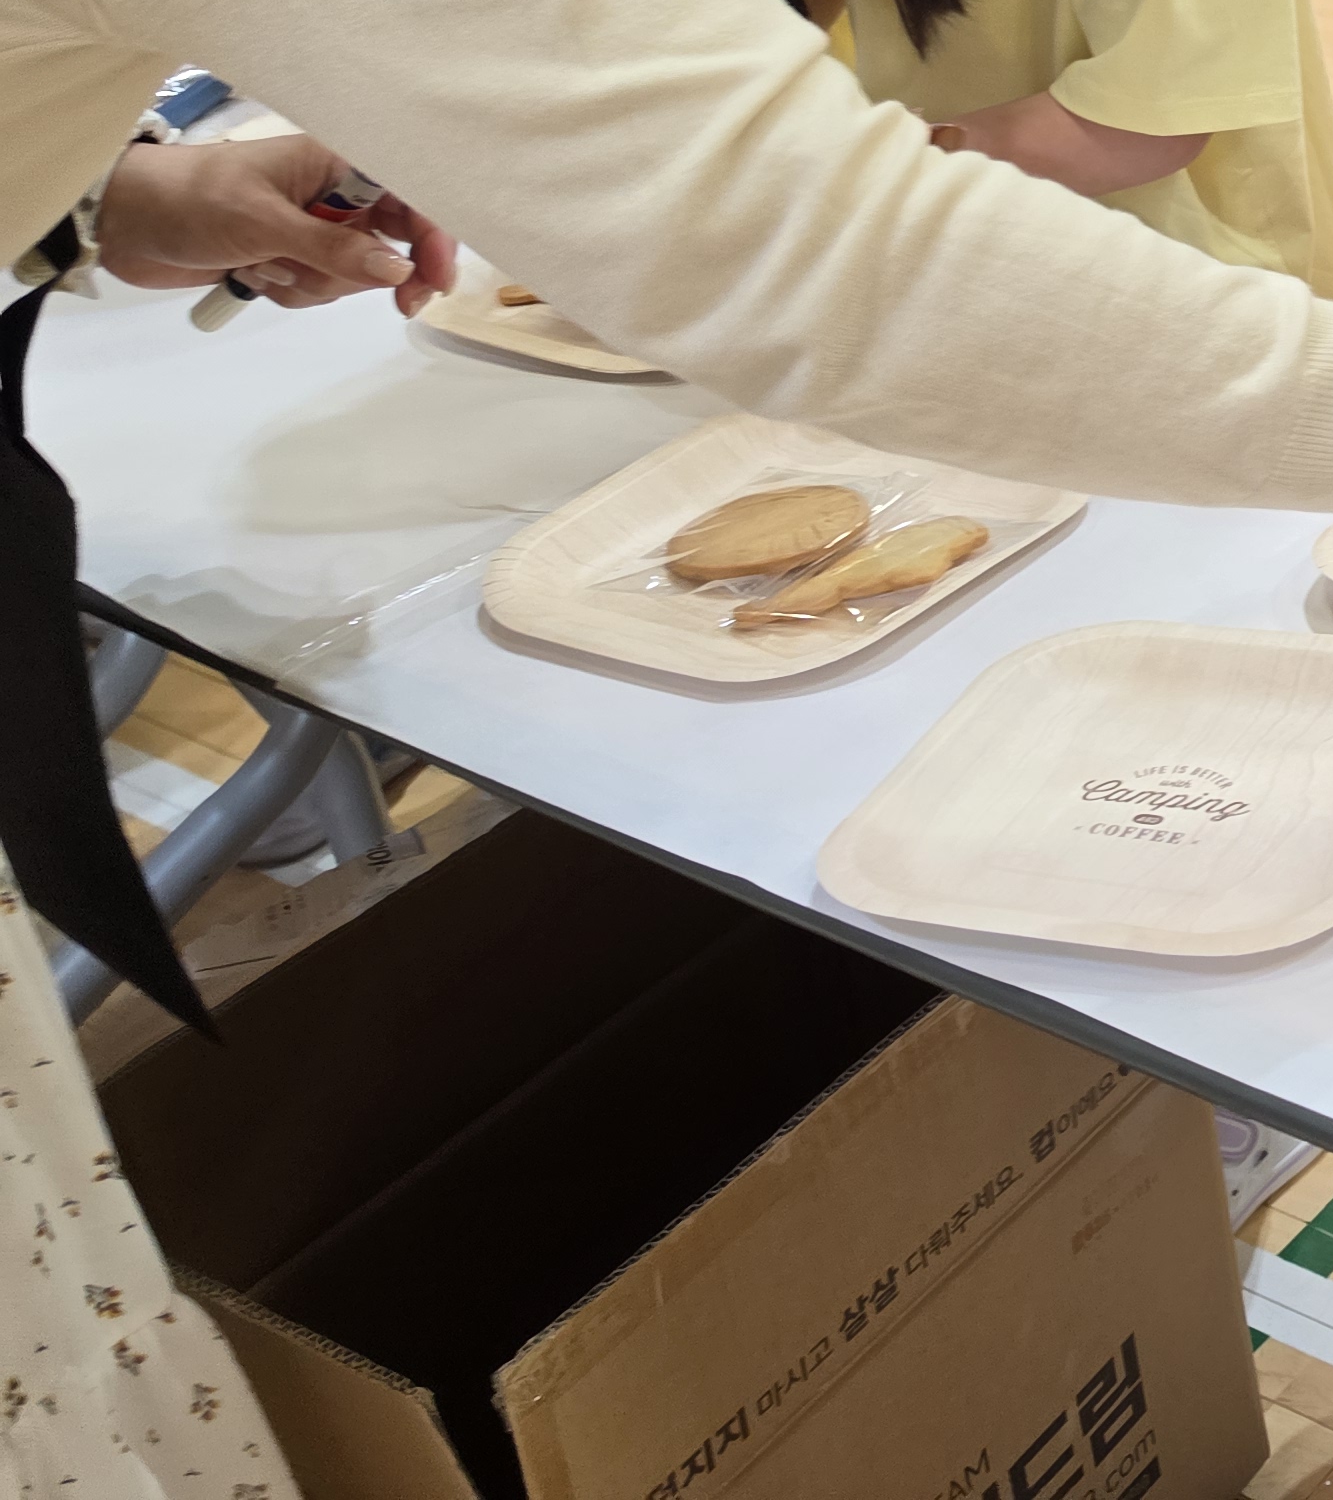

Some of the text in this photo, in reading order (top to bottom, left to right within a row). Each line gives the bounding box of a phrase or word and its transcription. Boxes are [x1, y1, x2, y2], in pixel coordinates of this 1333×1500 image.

[1133, 765, 1234, 790] LIFE IS BETTER
[1159, 780, 1193, 789] with
[1082, 779, 1251, 822] Camping
[1089, 822, 1186, 845] COFFEE
[755, 1335, 835, 1416] 마시고
[838, 1266, 899, 1342] 살살
[904, 1166, 1025, 1277] 다뤄주세요
